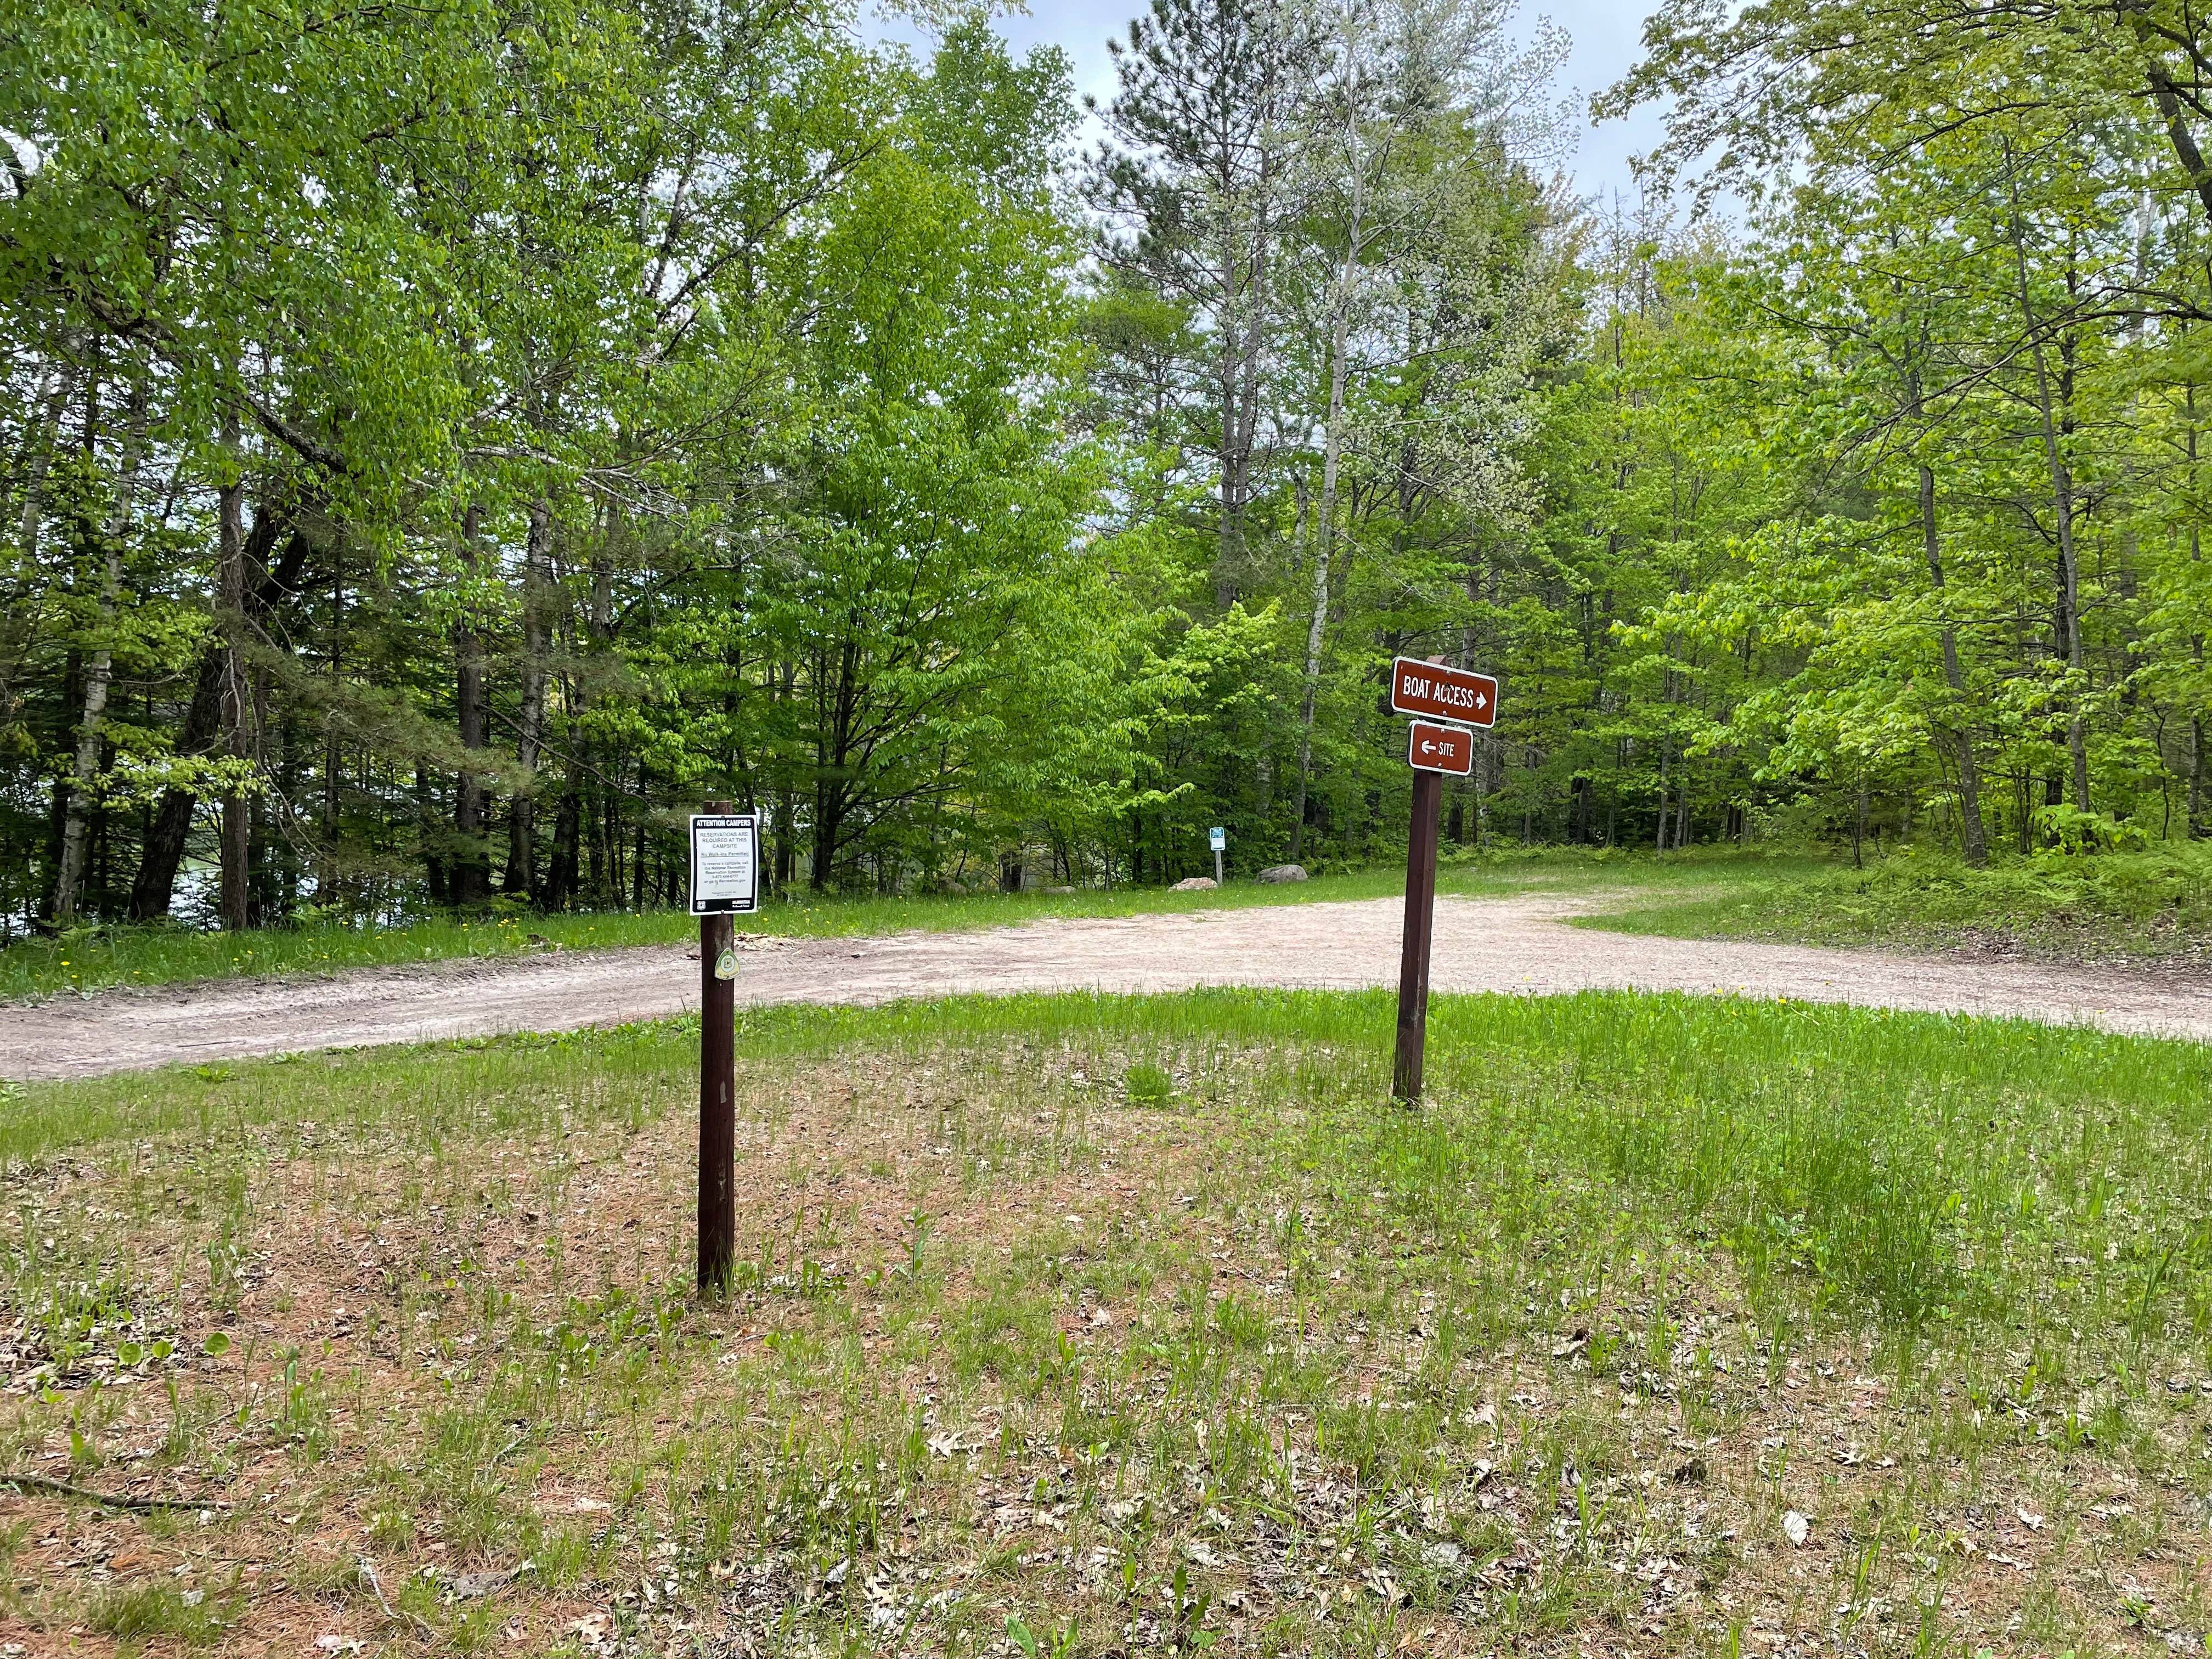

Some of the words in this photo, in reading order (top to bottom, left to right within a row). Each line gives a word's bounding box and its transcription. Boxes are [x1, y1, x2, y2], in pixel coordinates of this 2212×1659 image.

[1403, 675, 1431, 699] BOAT
[1433, 682, 1474, 708] ACCESS
[1438, 742, 1455, 757] SITE
